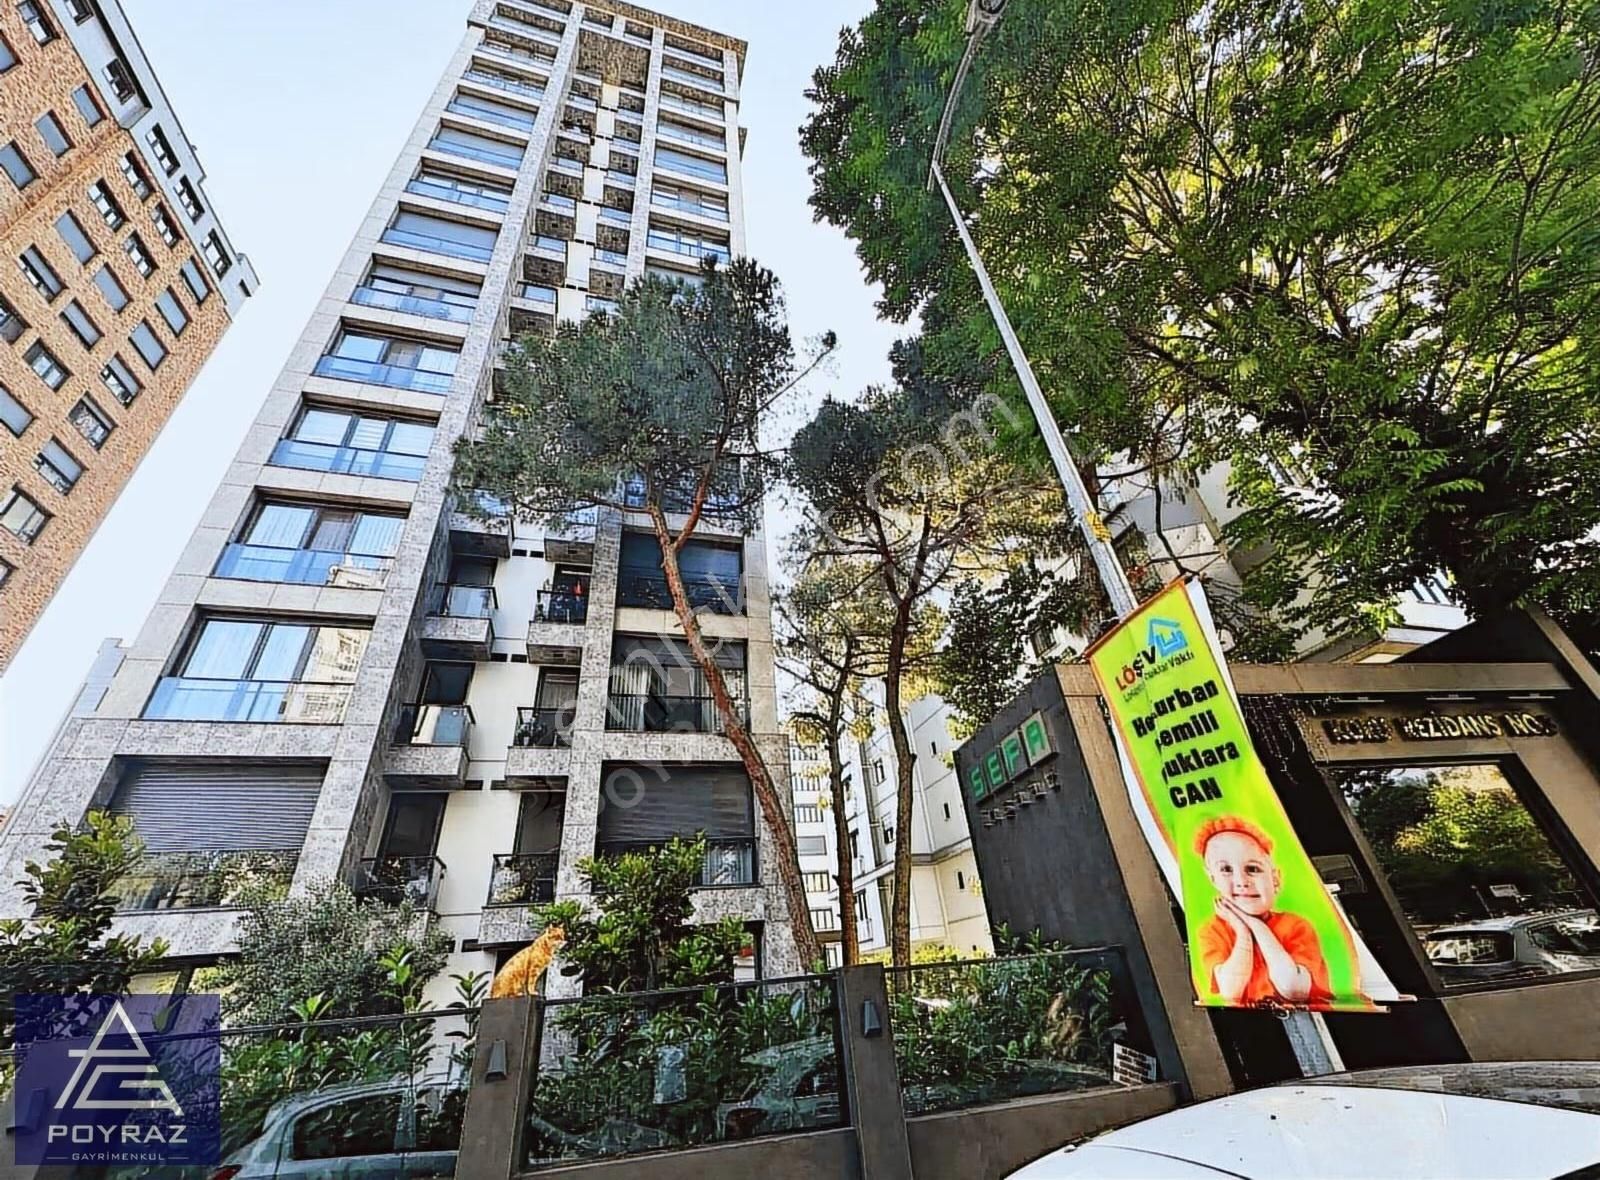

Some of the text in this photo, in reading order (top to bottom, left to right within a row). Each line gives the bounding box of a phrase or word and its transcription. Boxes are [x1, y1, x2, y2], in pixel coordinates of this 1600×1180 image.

[1153, 680, 1219, 717] urban
[1162, 741, 1240, 785] uklara
[1169, 777, 1223, 808] CAN
